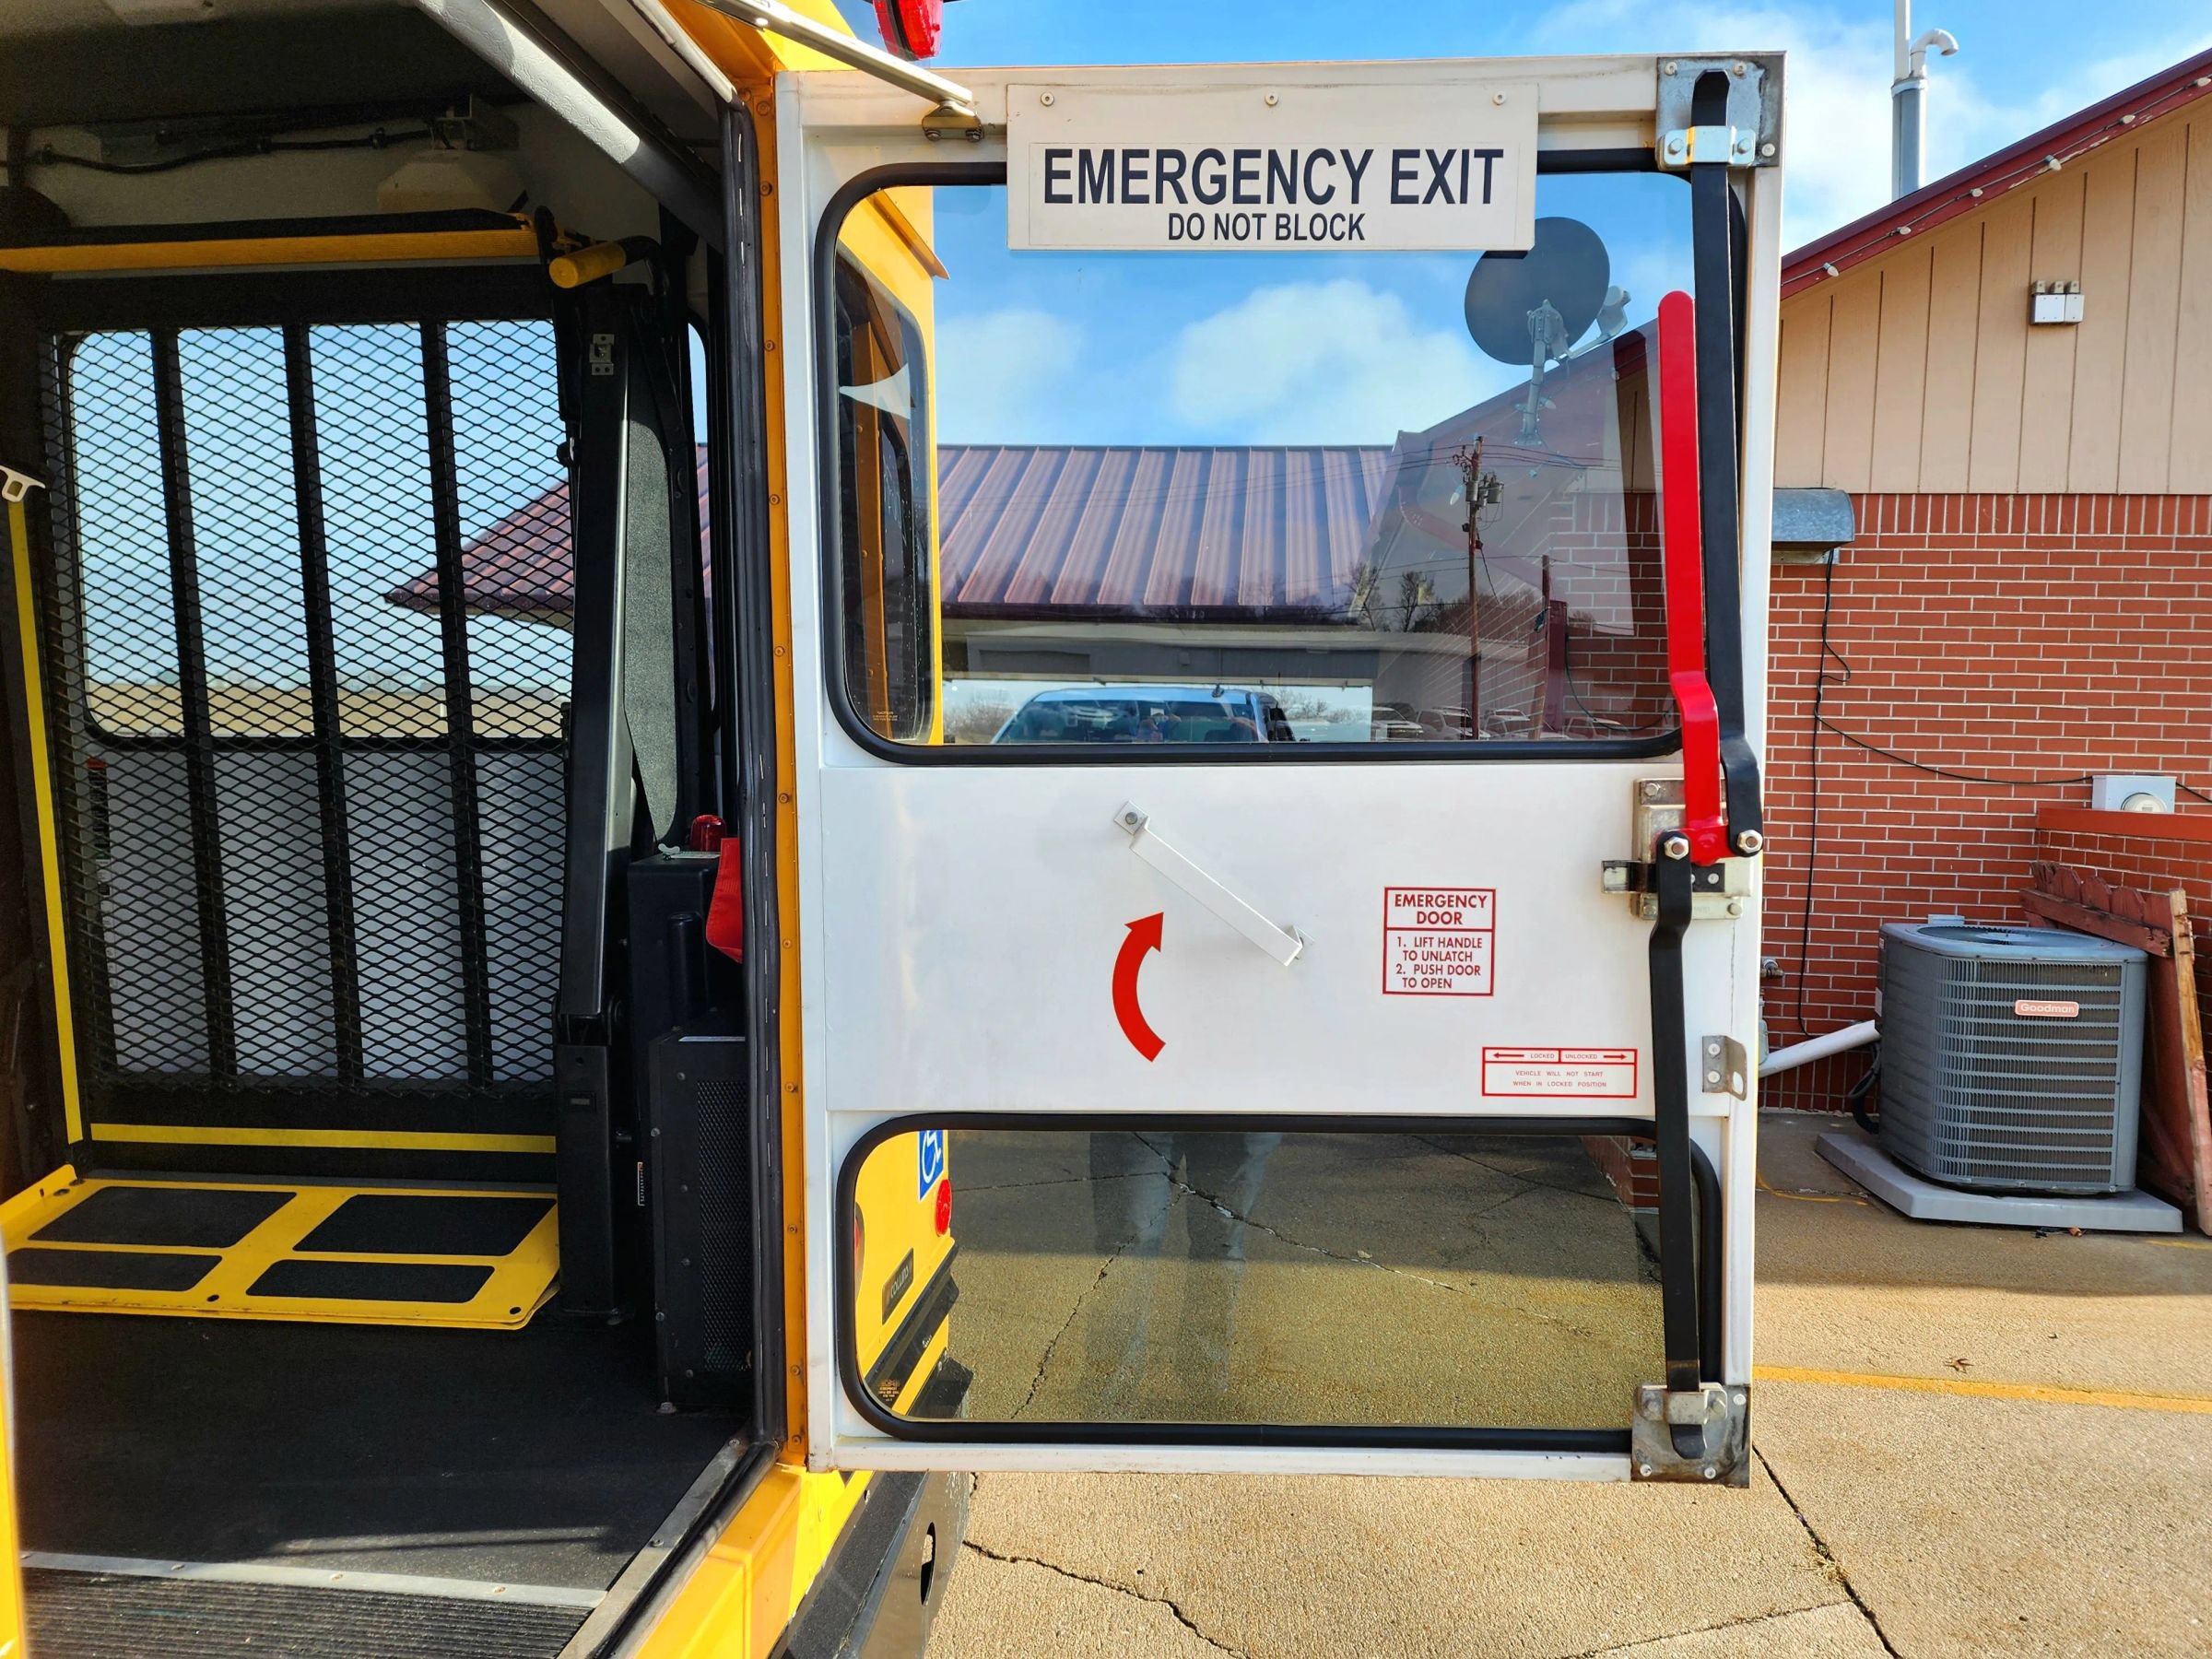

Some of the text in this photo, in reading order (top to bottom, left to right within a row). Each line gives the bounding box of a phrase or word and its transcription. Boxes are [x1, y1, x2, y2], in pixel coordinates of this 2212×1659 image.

[1044, 148, 1504, 205] EMERGENCY EXIT
[1168, 212, 1366, 241] DO NOT BLOCK
[1394, 894, 1488, 908] EMERGENCY
[1417, 911, 1463, 924] DOOR
[1397, 936, 1482, 948] 1. LIFT HANDLE
[1403, 950, 1473, 962] TO UNLATCH
[1395, 963, 1481, 976] 2. PUSH DOOR
[1402, 977, 1453, 989] TO OPEN
[2020, 1003, 2075, 1013] Goodman
